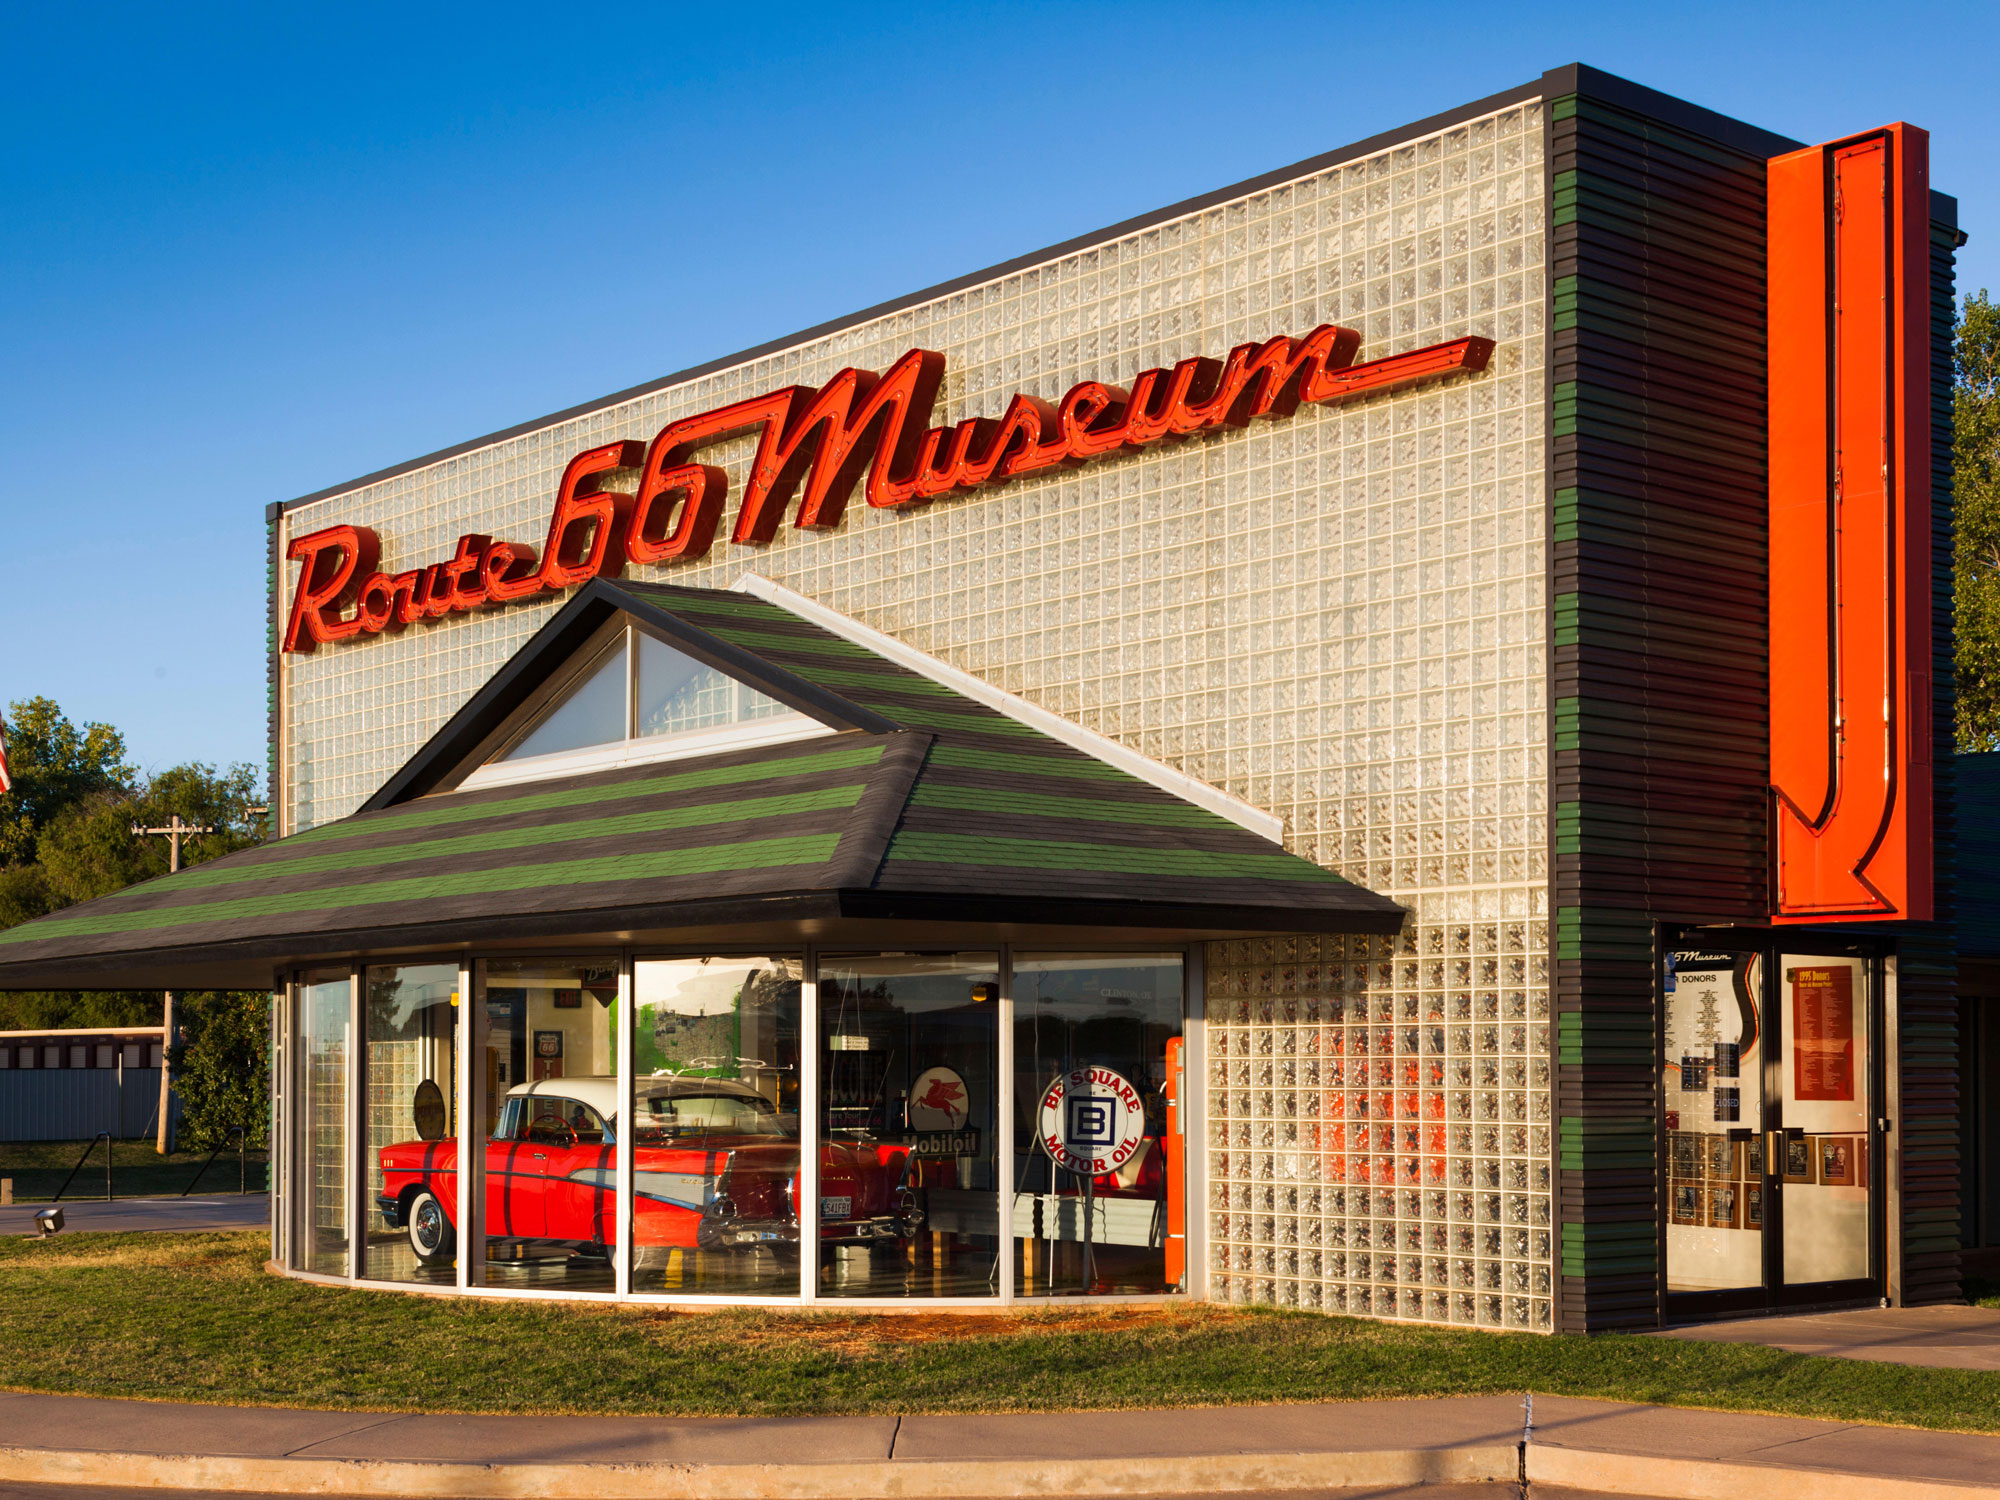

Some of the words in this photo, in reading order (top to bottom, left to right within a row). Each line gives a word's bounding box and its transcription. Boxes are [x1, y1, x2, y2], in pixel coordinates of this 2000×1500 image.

[282, 524, 538, 654] Route
[540, 412, 729, 589] 66
[731, 324, 1496, 547] Museum
[1683, 951, 1732, 962] Museum
[1681, 974, 1717, 983] DONORS
[559, 991, 577, 1006] EXIT
[542, 1043, 555, 1052] 66
[1044, 1082, 1067, 1111] BE
[1070, 1069, 1141, 1114] SQUARE
[902, 1132, 976, 1154] Mobiloil
[1045, 1133, 1108, 1173] MOTOR
[1112, 1136, 1139, 1164] OIL
